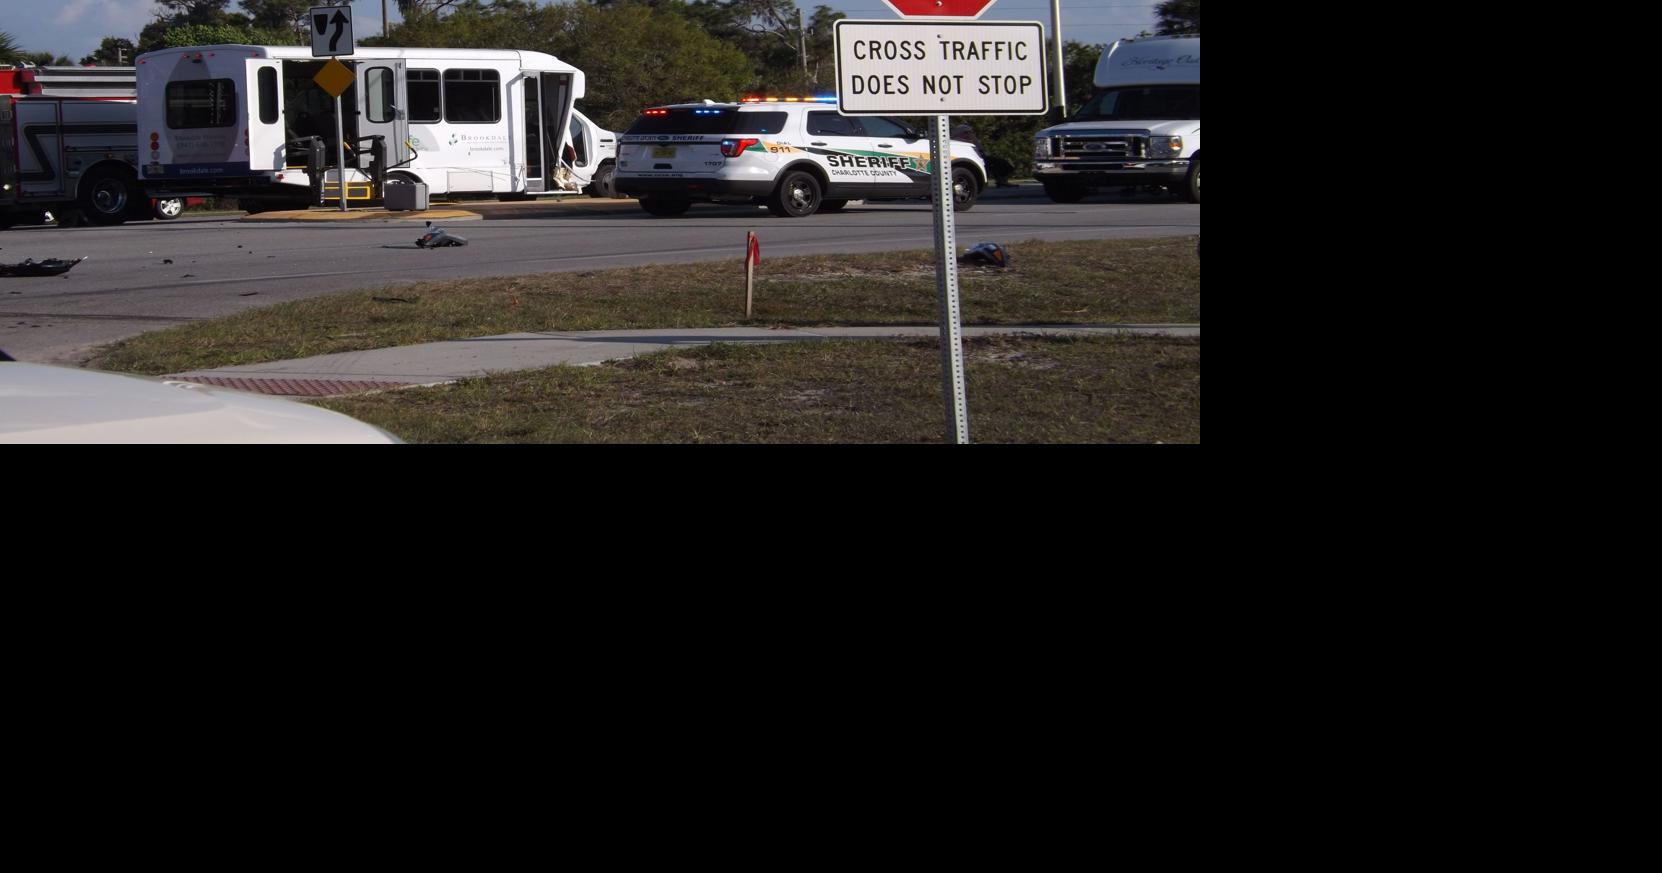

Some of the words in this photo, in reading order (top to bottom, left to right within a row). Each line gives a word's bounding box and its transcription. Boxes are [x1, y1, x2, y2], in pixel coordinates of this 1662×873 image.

[853, 40, 926, 61] CROSS
[939, 40, 1028, 61] TRAFFIC
[851, 74, 910, 95] DOES
[922, 75, 964, 95] NOT
[978, 75, 1032, 95] STOP
[770, 146, 791, 154] 911
[826, 155, 912, 170] SHERIFF
[831, 169, 870, 177] CHARLOTTE
[871, 169, 897, 177] COUNTY
